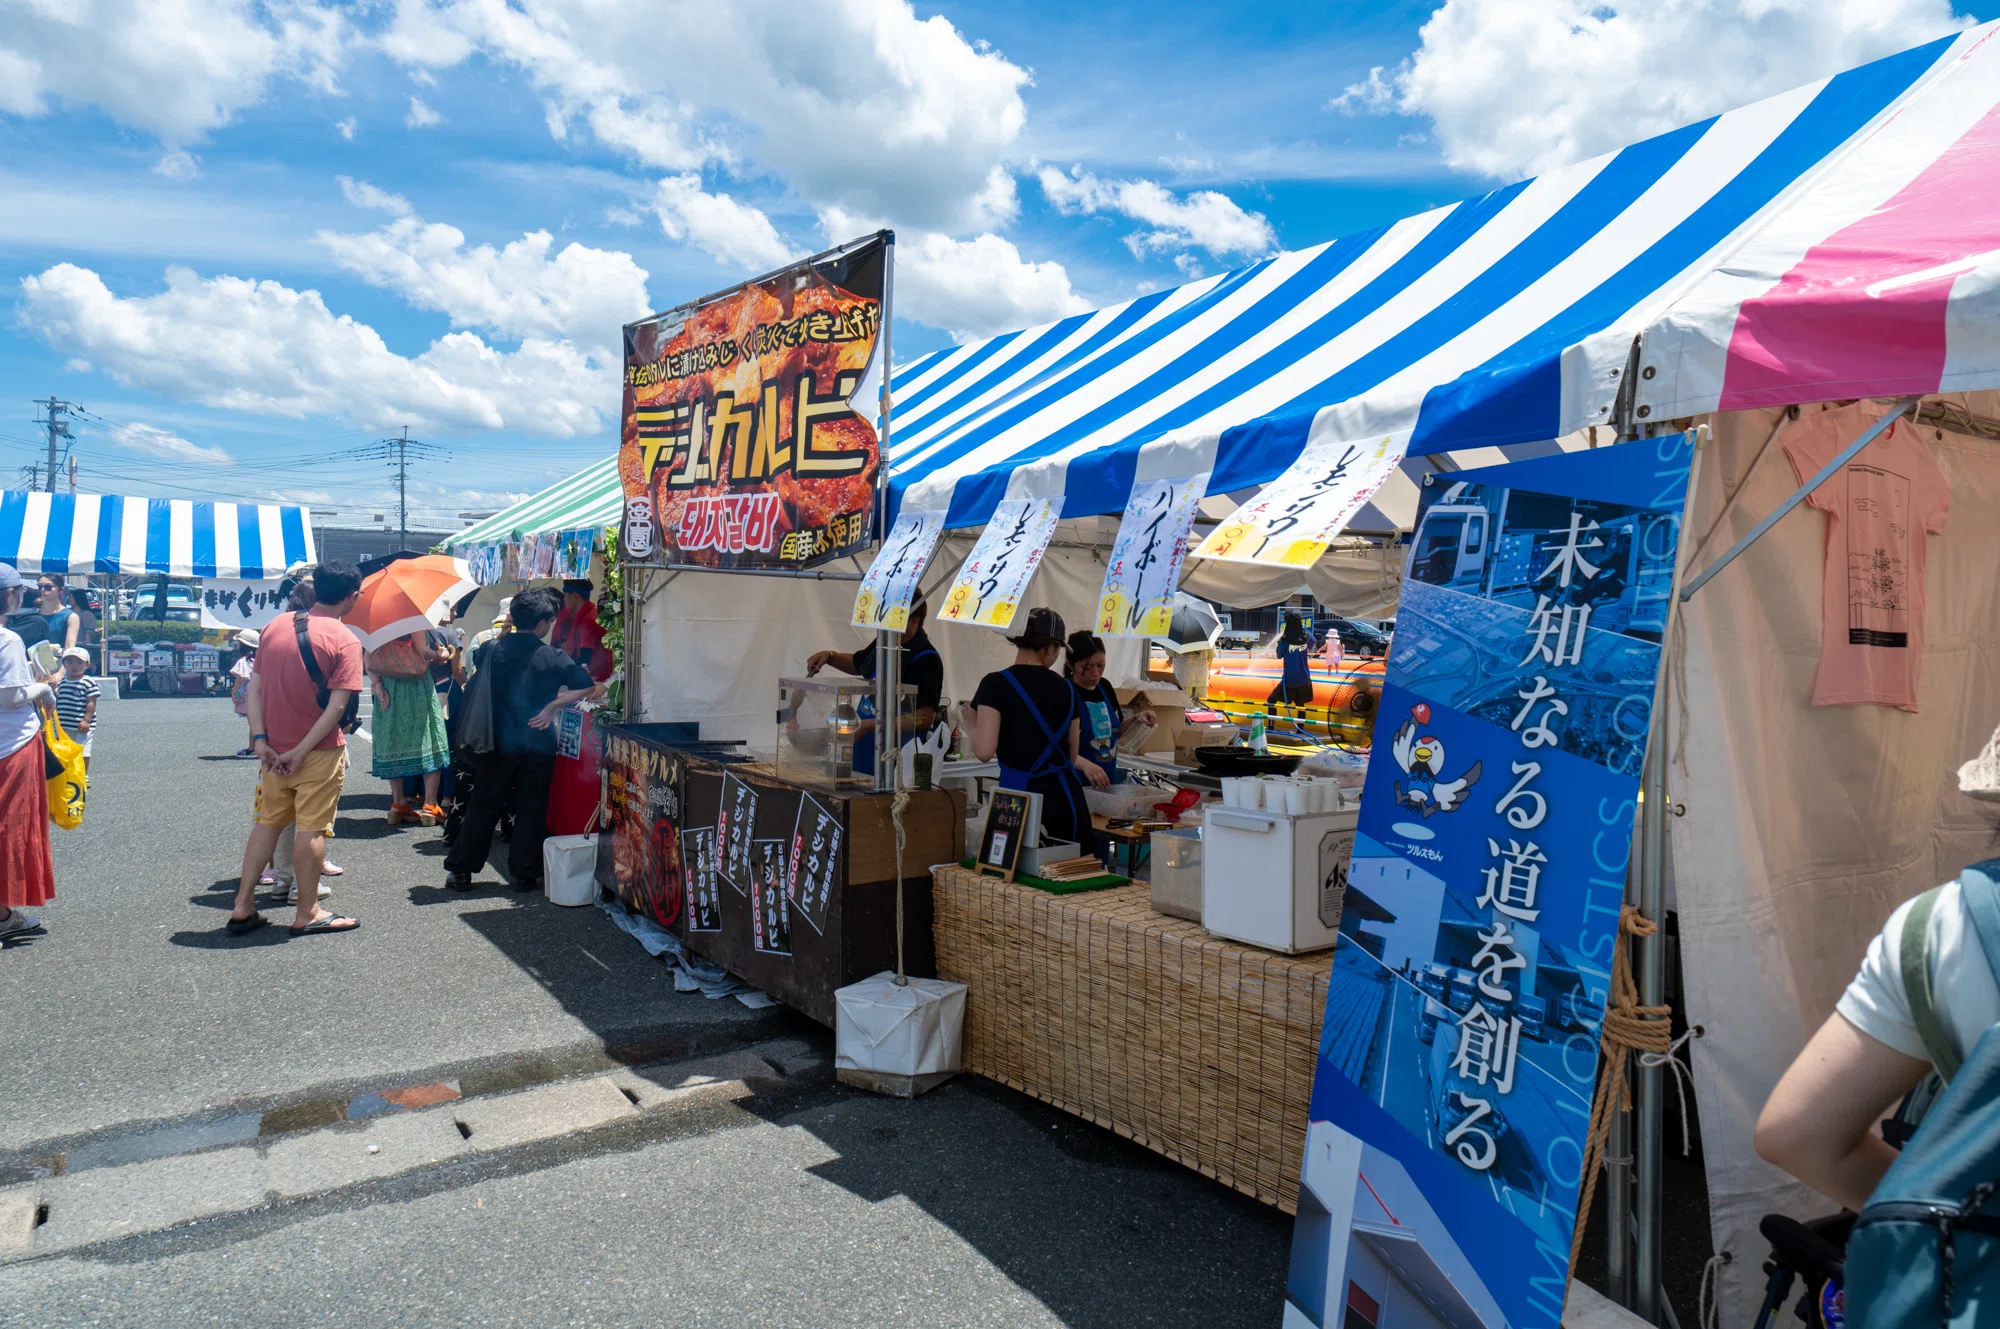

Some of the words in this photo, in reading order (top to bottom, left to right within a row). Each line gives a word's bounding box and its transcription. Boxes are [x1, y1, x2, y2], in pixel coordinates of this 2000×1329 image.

[676, 493, 780, 554] 돼지갈비
[873, 516, 925, 624] ハイボール
[1125, 485, 1174, 630] ハイボール
[696, 831, 710, 927] デジカルビ
[801, 813, 830, 913] デジカルビ
[1444, 511, 1605, 1171] 未知なる道を創る
[764, 843, 779, 948] デジカルビ
[1555, 796, 1637, 1120] LOGISTICS
[1539, 1135, 1584, 1219] TO
